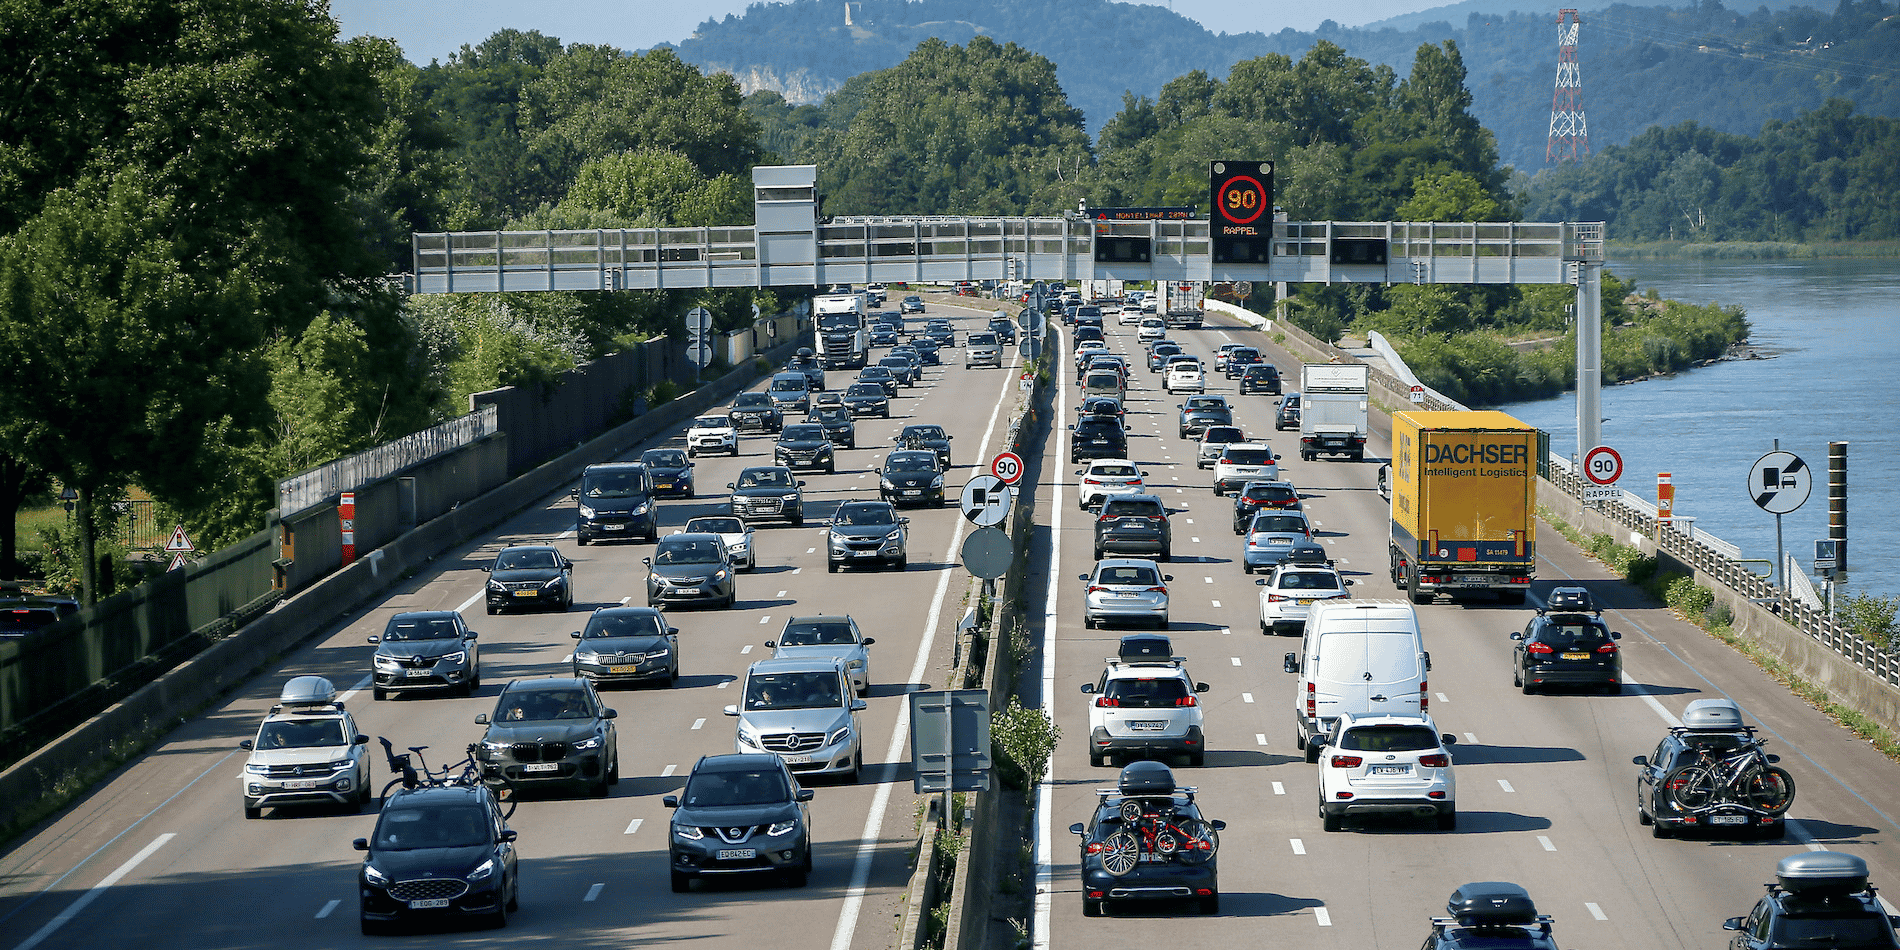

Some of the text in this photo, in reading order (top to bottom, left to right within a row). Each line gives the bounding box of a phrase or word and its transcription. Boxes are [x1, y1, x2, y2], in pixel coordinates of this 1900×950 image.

[1228, 189, 1256, 209] 90
[1223, 226, 1258, 235] RAPPEL
[1425, 443, 1528, 464] DACHSER
[997, 461, 1017, 475] 90
[1424, 467, 1528, 479] Intelligent Logistics
[1593, 460, 1614, 473] 90
[1585, 489, 1622, 498] RAPPEL
